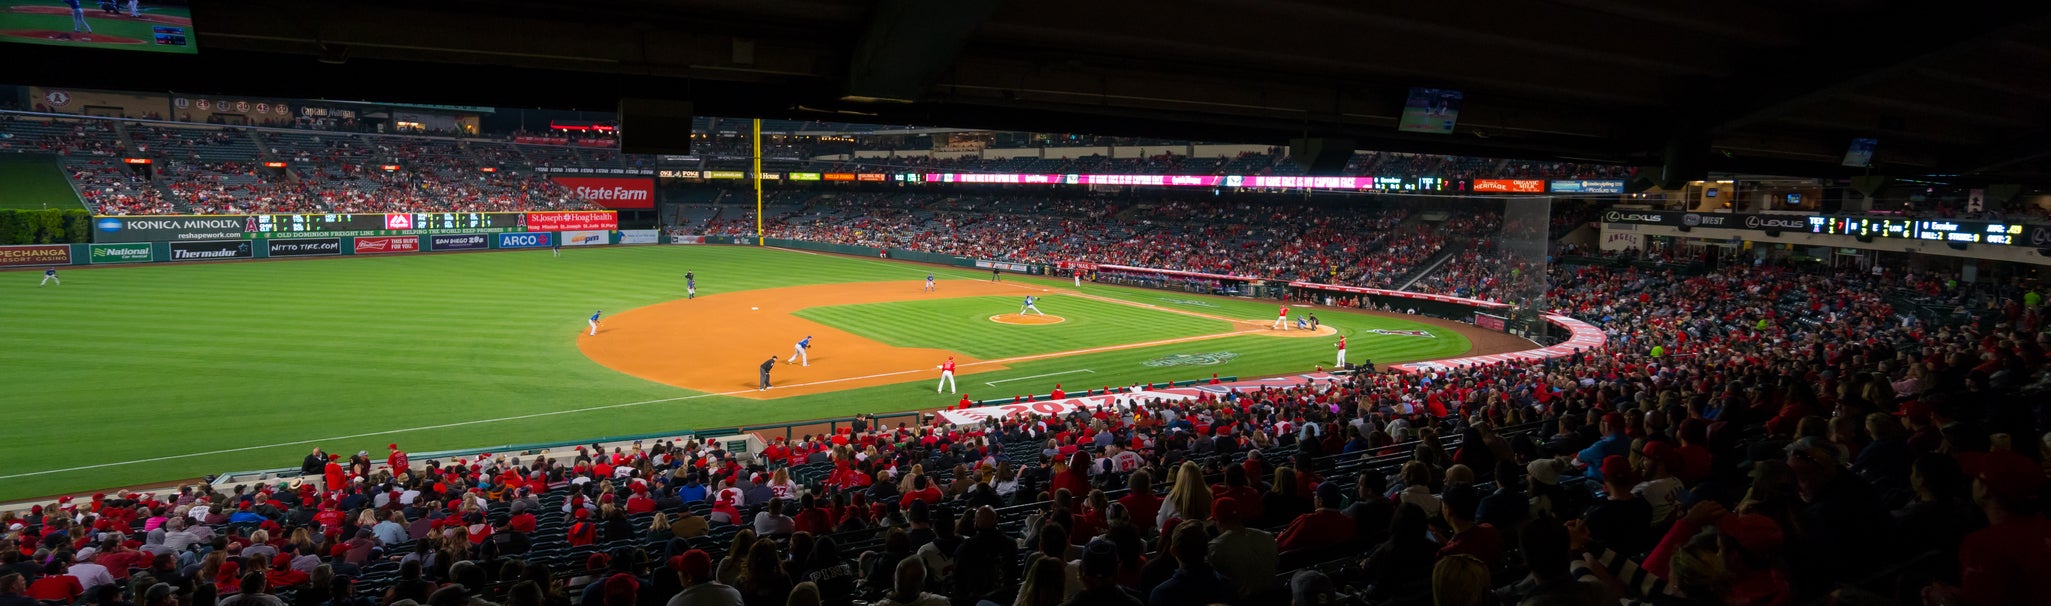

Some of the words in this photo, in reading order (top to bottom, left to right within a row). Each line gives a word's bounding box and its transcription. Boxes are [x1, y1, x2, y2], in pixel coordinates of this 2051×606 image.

[1474, 183, 1507, 191] HERITAGE
[1621, 214, 1662, 222] LEXUS
[1702, 217, 1725, 225] WEST
[1809, 217, 1825, 225] TEX
[1829, 218, 1836, 226] 5
[127, 219, 181, 230] KONICA
[184, 219, 240, 229] MINOLTA
[1760, 219, 1804, 228] LEXUS
[1837, 222, 1843, 230] 7
[1862, 219, 1868, 227] 9
[1884, 220, 1890, 228] 2
[1904, 220, 1911, 229] 7
[1931, 222, 1958, 232] Escobar
[1829, 226, 1834, 234] 1
[1860, 227, 1867, 236] 3
[1882, 228, 1888, 237] 1
[1903, 230, 1910, 238] 6
[178, 231, 241, 239] reshapework.com
[1608, 233, 1637, 244] ANGELS
[503, 236, 537, 246] ARCO
[300, 243, 338, 251] TIRE.COM
[107, 248, 149, 256] National
[174, 249, 237, 259] Thermador
[1000, 395, 1116, 418] 2017
[772, 487, 786, 497] 27
